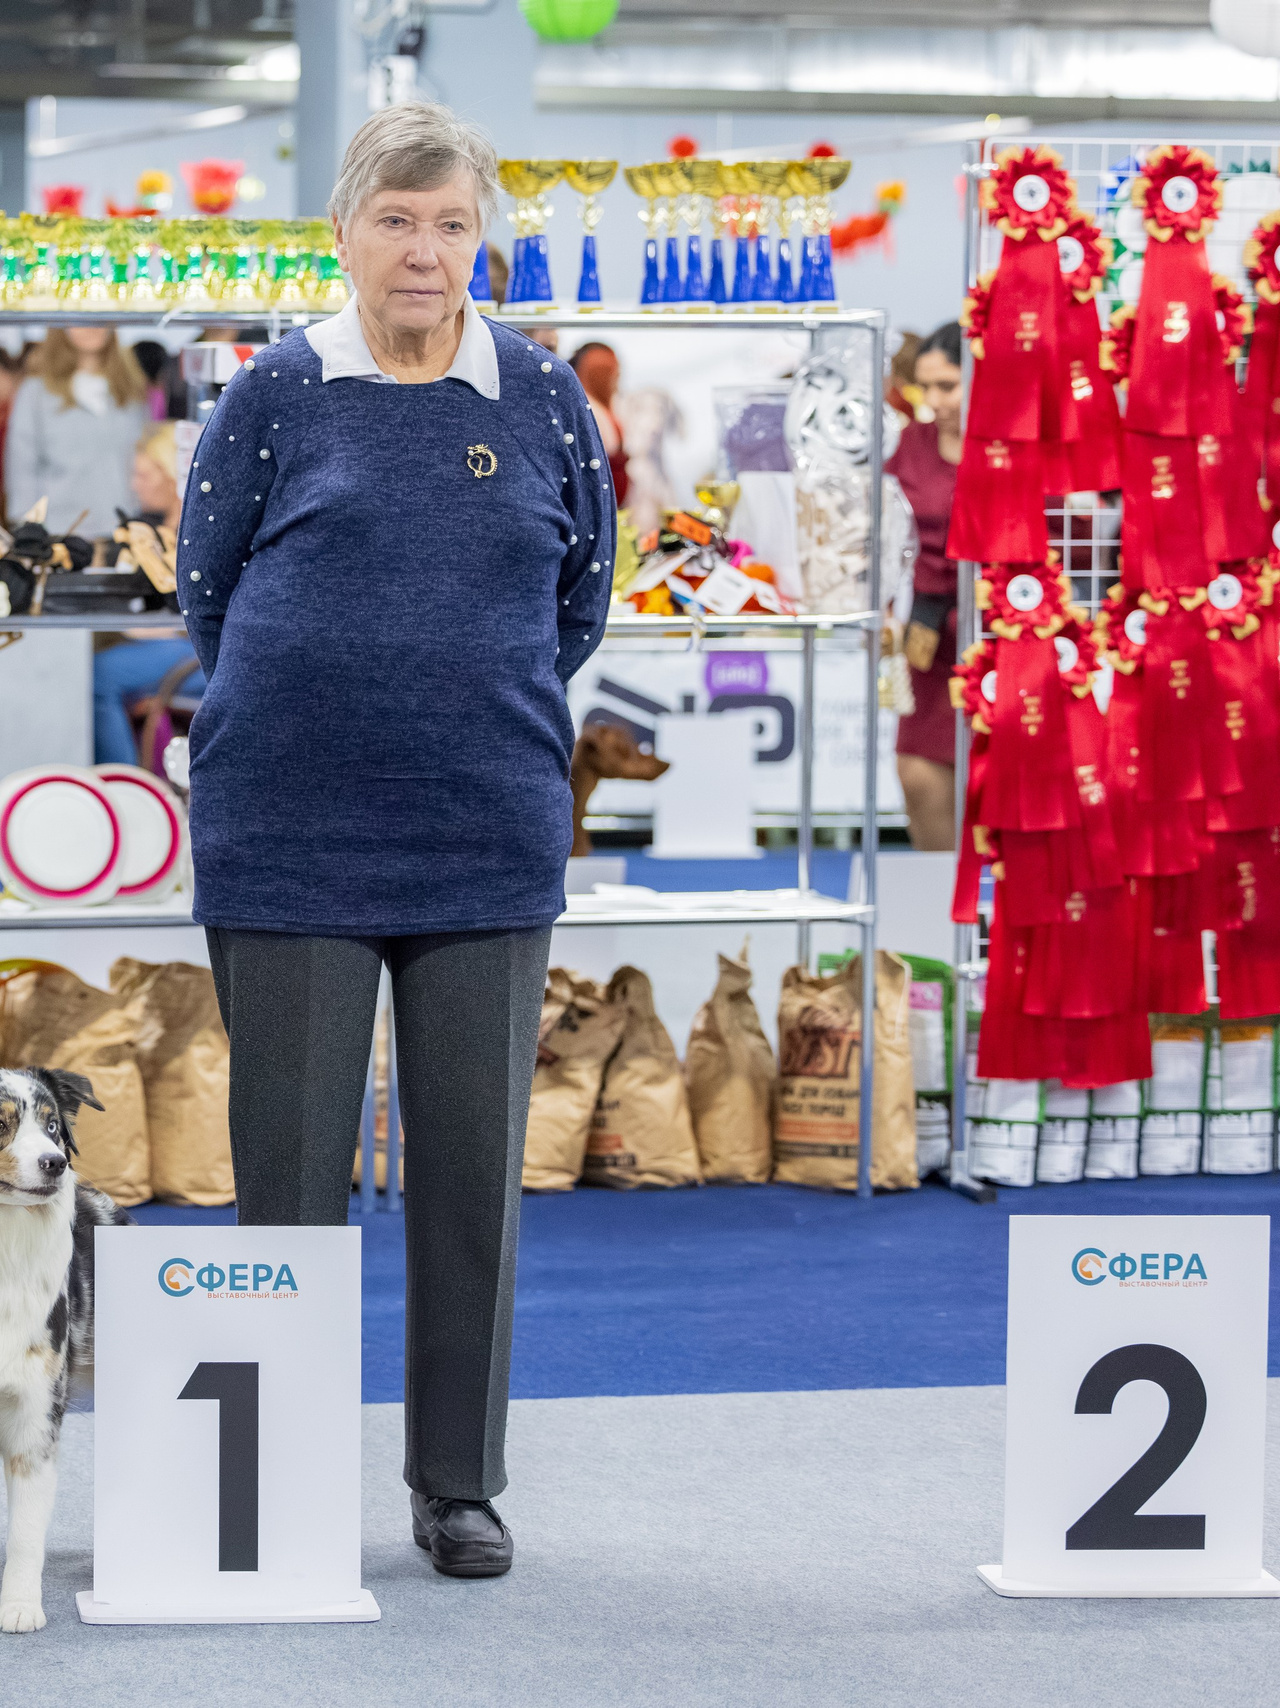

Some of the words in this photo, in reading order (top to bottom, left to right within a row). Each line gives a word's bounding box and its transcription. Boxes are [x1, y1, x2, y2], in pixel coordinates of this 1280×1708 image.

[158, 1257, 299, 1298] СФЕРА
[1071, 1247, 1208, 1286] СФЕРА
[1119, 1280, 1180, 1288] ВЫСТАВОЧНЫЙ
[1182, 1280, 1209, 1288] ЦЕНТР
[207, 1291, 270, 1299] ВЫСТАВОЧНЫЙ
[272, 1292, 299, 1300] ЦЕНТР
[176, 1362, 259, 1572] 1
[1065, 1343, 1208, 1551] 2
